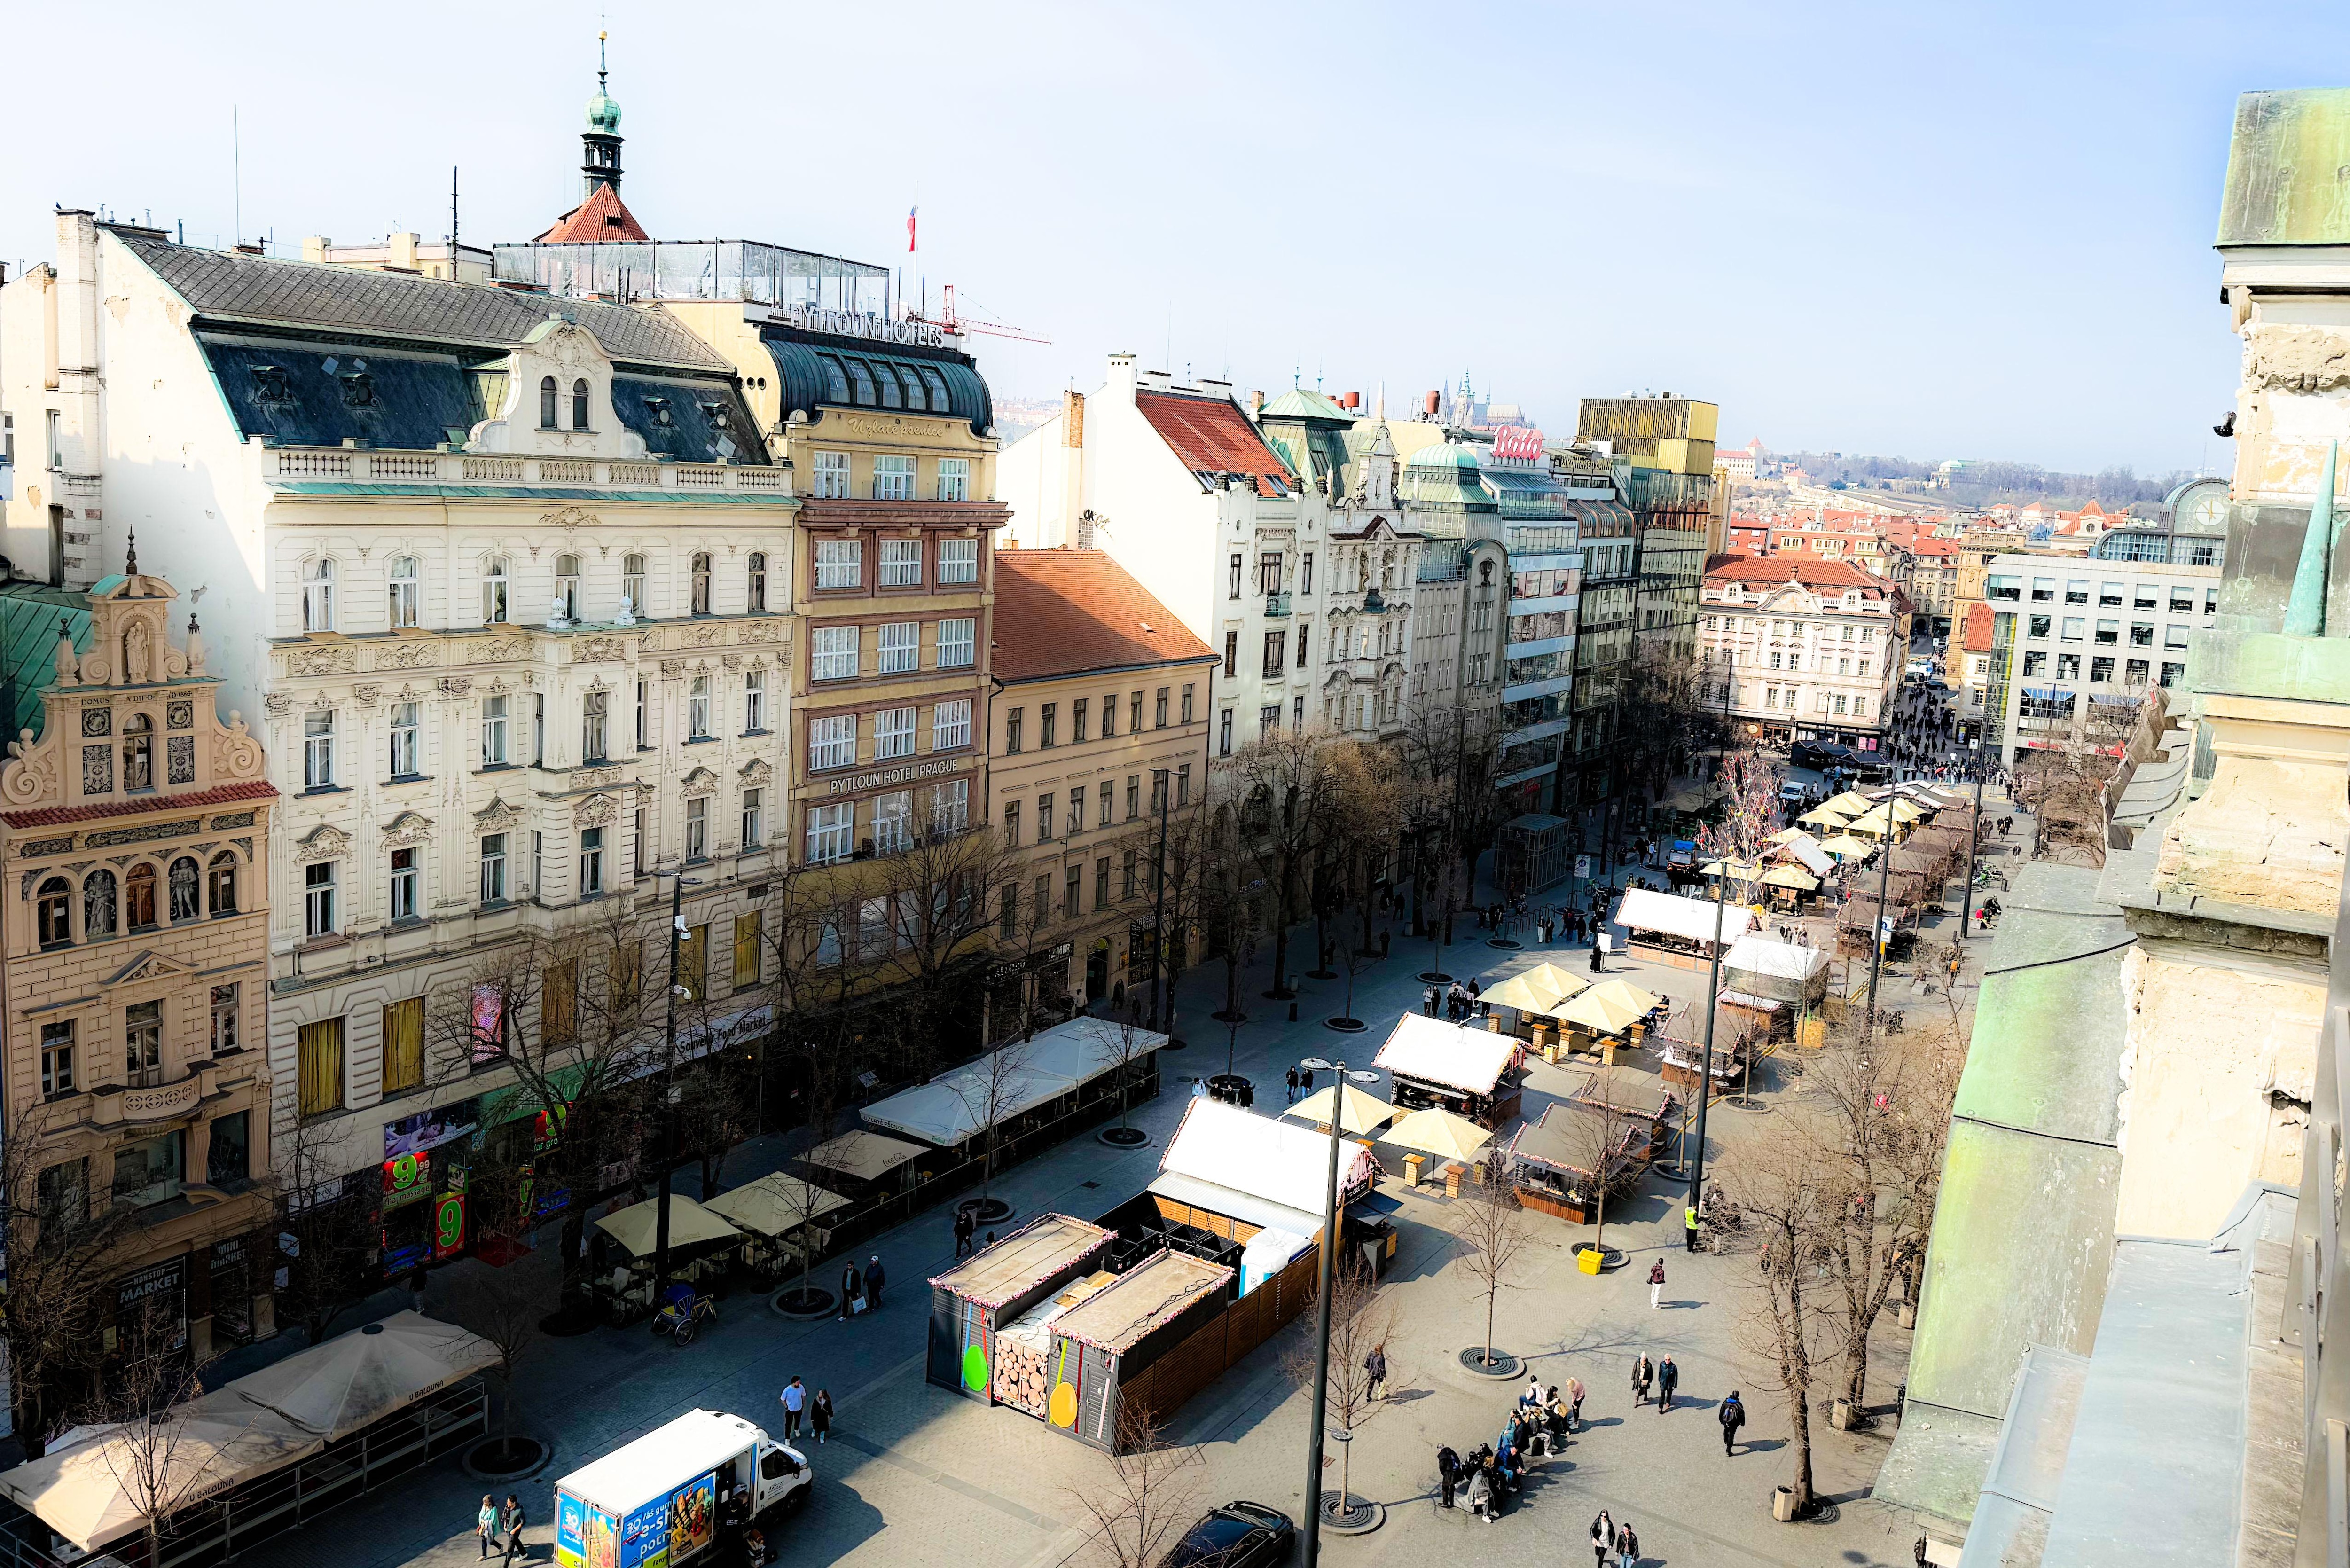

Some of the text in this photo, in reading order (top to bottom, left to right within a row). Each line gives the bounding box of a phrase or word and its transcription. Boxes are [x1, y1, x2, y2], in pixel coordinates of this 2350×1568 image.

[791, 305, 944, 349] PYTLOUN HOTELS
[830, 759, 958, 795] PYTLOUN HOTEL PRAGUE
[400, 1185, 430, 1200] massage
[119, 1272, 180, 1303] MARKET
[133, 1268, 166, 1286] NONSTOP
[409, 1380, 444, 1401] U BALOUNA
[189, 1477, 235, 1502] U BALOUNA
